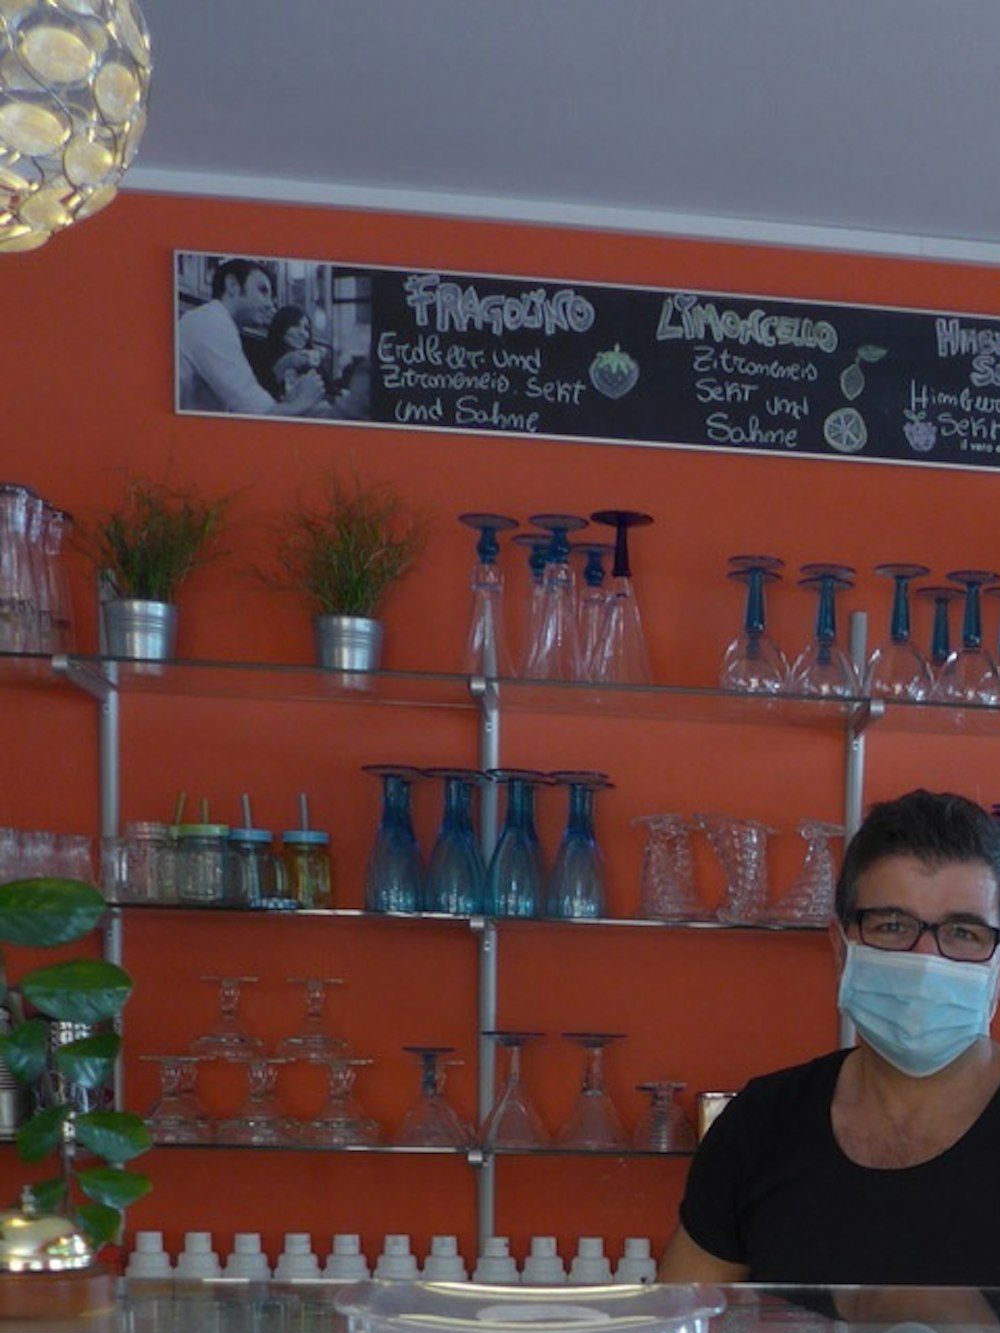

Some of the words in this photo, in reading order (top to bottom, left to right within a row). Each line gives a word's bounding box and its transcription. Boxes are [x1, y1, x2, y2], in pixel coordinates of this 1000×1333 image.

[525, 376, 586, 405] Sekt
[455, 395, 540, 432] Sahne
[706, 411, 798, 447] Sahne
